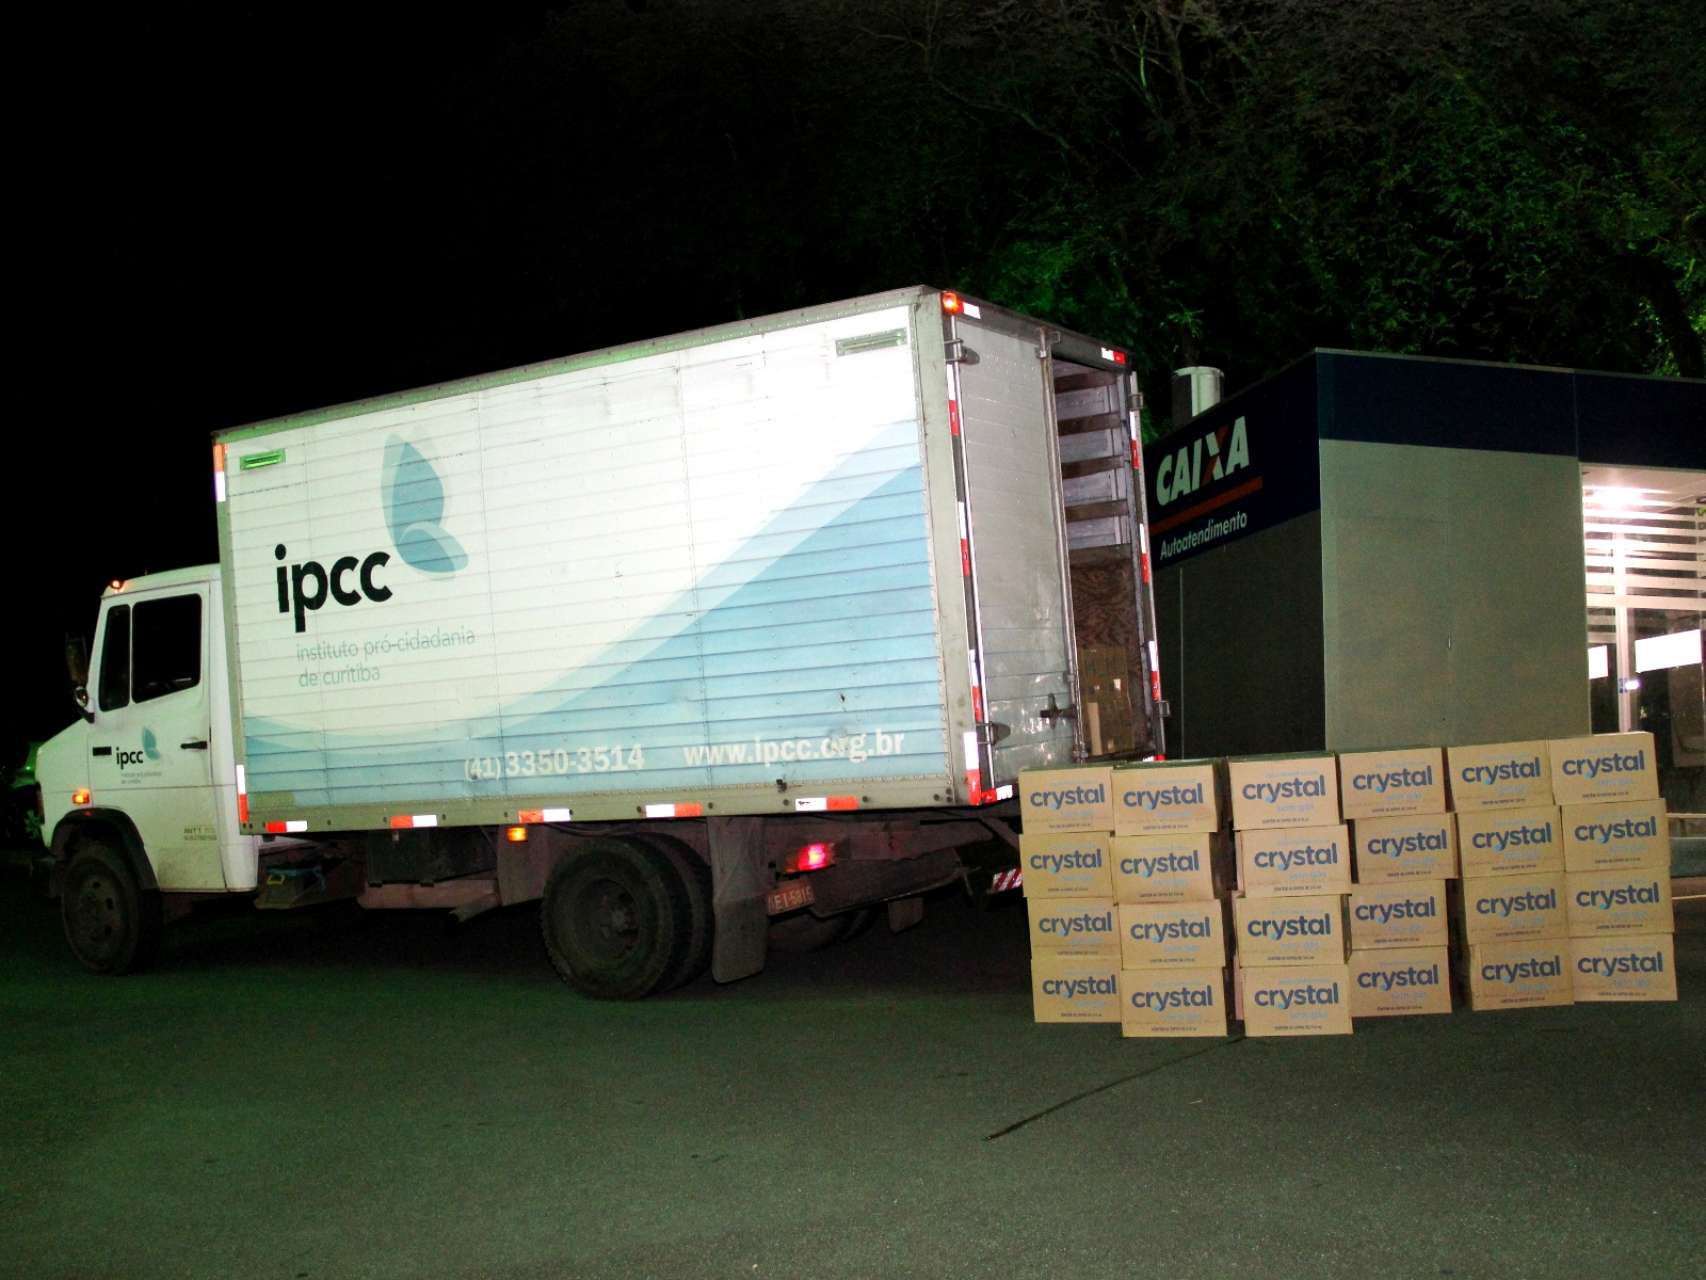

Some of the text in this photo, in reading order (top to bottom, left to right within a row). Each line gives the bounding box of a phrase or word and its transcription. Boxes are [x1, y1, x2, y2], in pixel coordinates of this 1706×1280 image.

[1156, 416, 1250, 506] CAIXA
[1160, 511, 1248, 560] Autoatendimento
[275, 543, 393, 633] ipcc
[296, 625, 476, 662] instituto pró-cidadania
[298, 662, 381, 688] de curitiba
[116, 746, 144, 770] ipcc
[684, 728, 905, 769] www.ipcc.org.br
[1461, 757, 1542, 785] crystal
[1562, 750, 1646, 779] crystal
[1242, 775, 1327, 803] crystal
[1353, 765, 1434, 793] crystal
[1030, 783, 1105, 810] crystal
[1123, 783, 1204, 810] crystal
[1367, 829, 1448, 857] crystal
[1472, 822, 1552, 850] crystal
[1574, 816, 1657, 843] crystal
[1030, 848, 1102, 874] crystal
[1120, 850, 1200, 878] crystal
[1254, 842, 1338, 871] crystal
[1476, 888, 1557, 916] crystal
[1575, 882, 1660, 909] crystal
[1039, 912, 1113, 936] crystal
[1355, 896, 1436, 924] crystal
[1130, 916, 1211, 942] crystal
[1247, 913, 1331, 940] crystal
[1357, 964, 1439, 991] crystal
[1481, 955, 1562, 983] crystal
[1577, 952, 1664, 977] crystal
[1042, 974, 1117, 999] crystal
[1131, 985, 1213, 1011] crystal
[1254, 982, 1339, 1009] crystal
